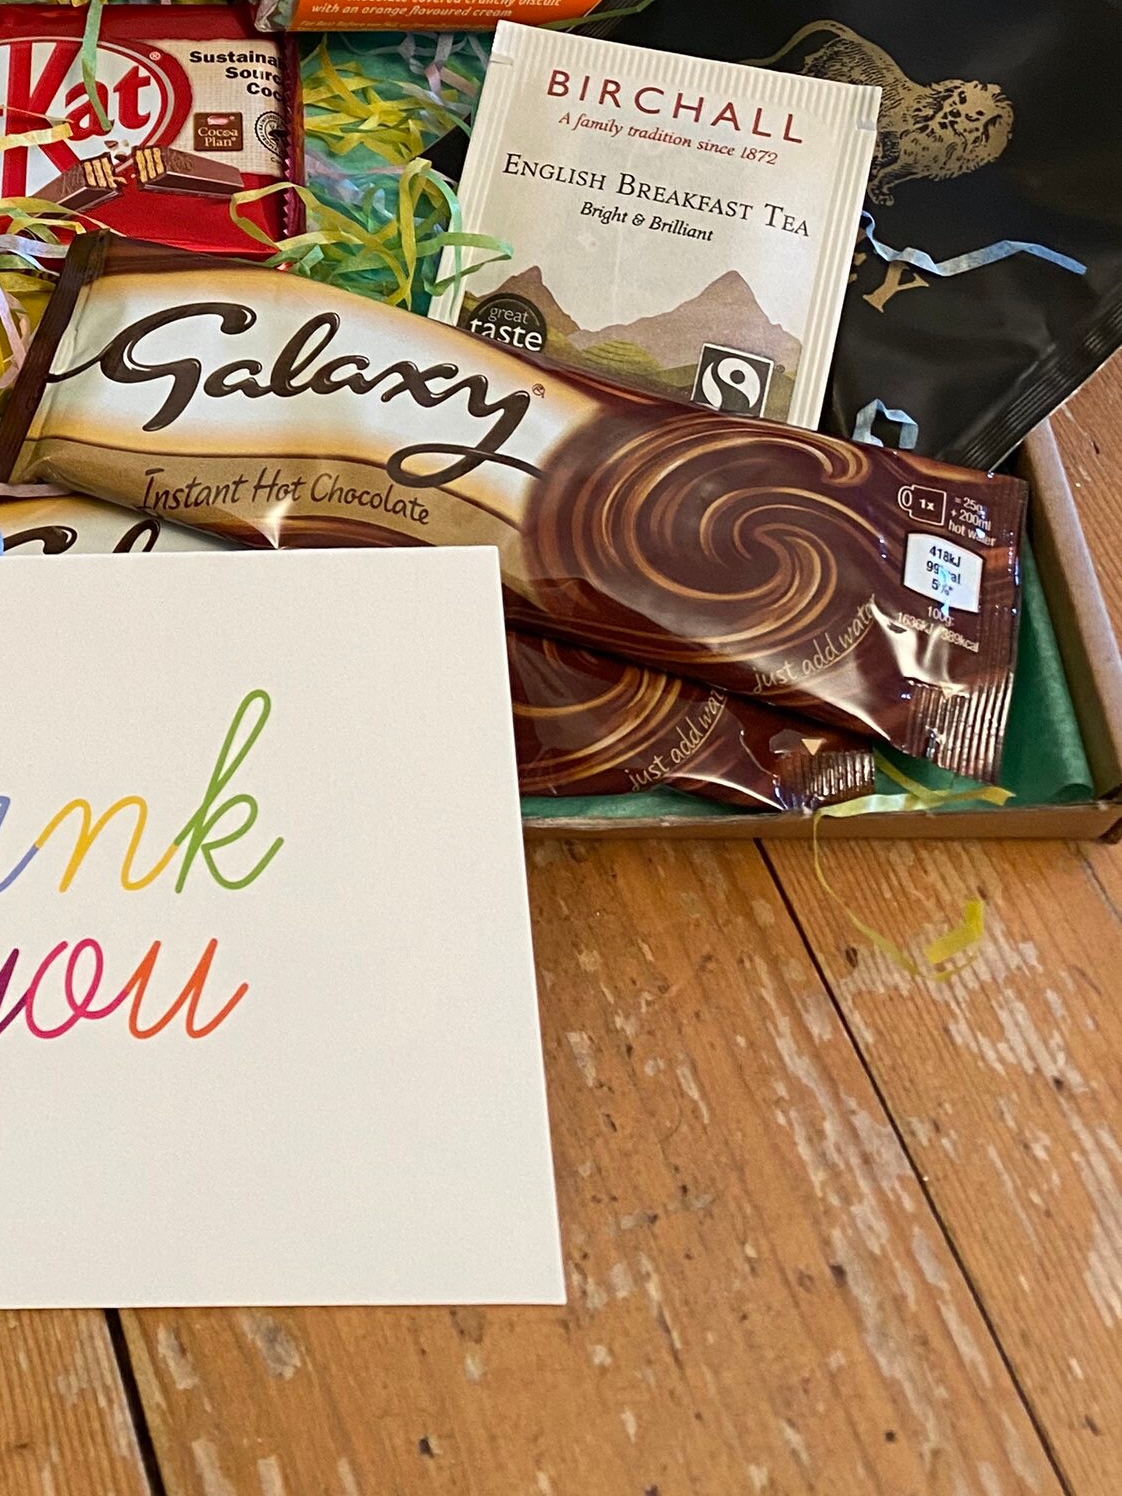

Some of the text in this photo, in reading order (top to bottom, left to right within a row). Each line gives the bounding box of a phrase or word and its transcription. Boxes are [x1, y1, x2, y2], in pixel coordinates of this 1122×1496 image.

[311, 4, 514, 18] with an orange flavoured cream
[546, 69, 804, 144] BIRCHALL
[198, 126, 238, 137] Cocoa
[204, 136, 232, 147] Plan
[558, 111, 779, 166] A family tradition since 1872
[580, 201, 714, 242] Bright & Brilliant
[487, 307, 530, 325] great
[469, 317, 543, 352] taste
[47, 301, 545, 488] Galaxy
[138, 466, 430, 526] Instant Hot Chocolate
[919, 498, 935, 512] 1x
[948, 519, 966, 537] hot
[959, 509, 992, 532] 200ml
[929, 545, 962, 568] 418kJ
[753, 661, 797, 694] just
[801, 633, 840, 676] add
[624, 754, 670, 792] just
[670, 717, 705, 764] add
